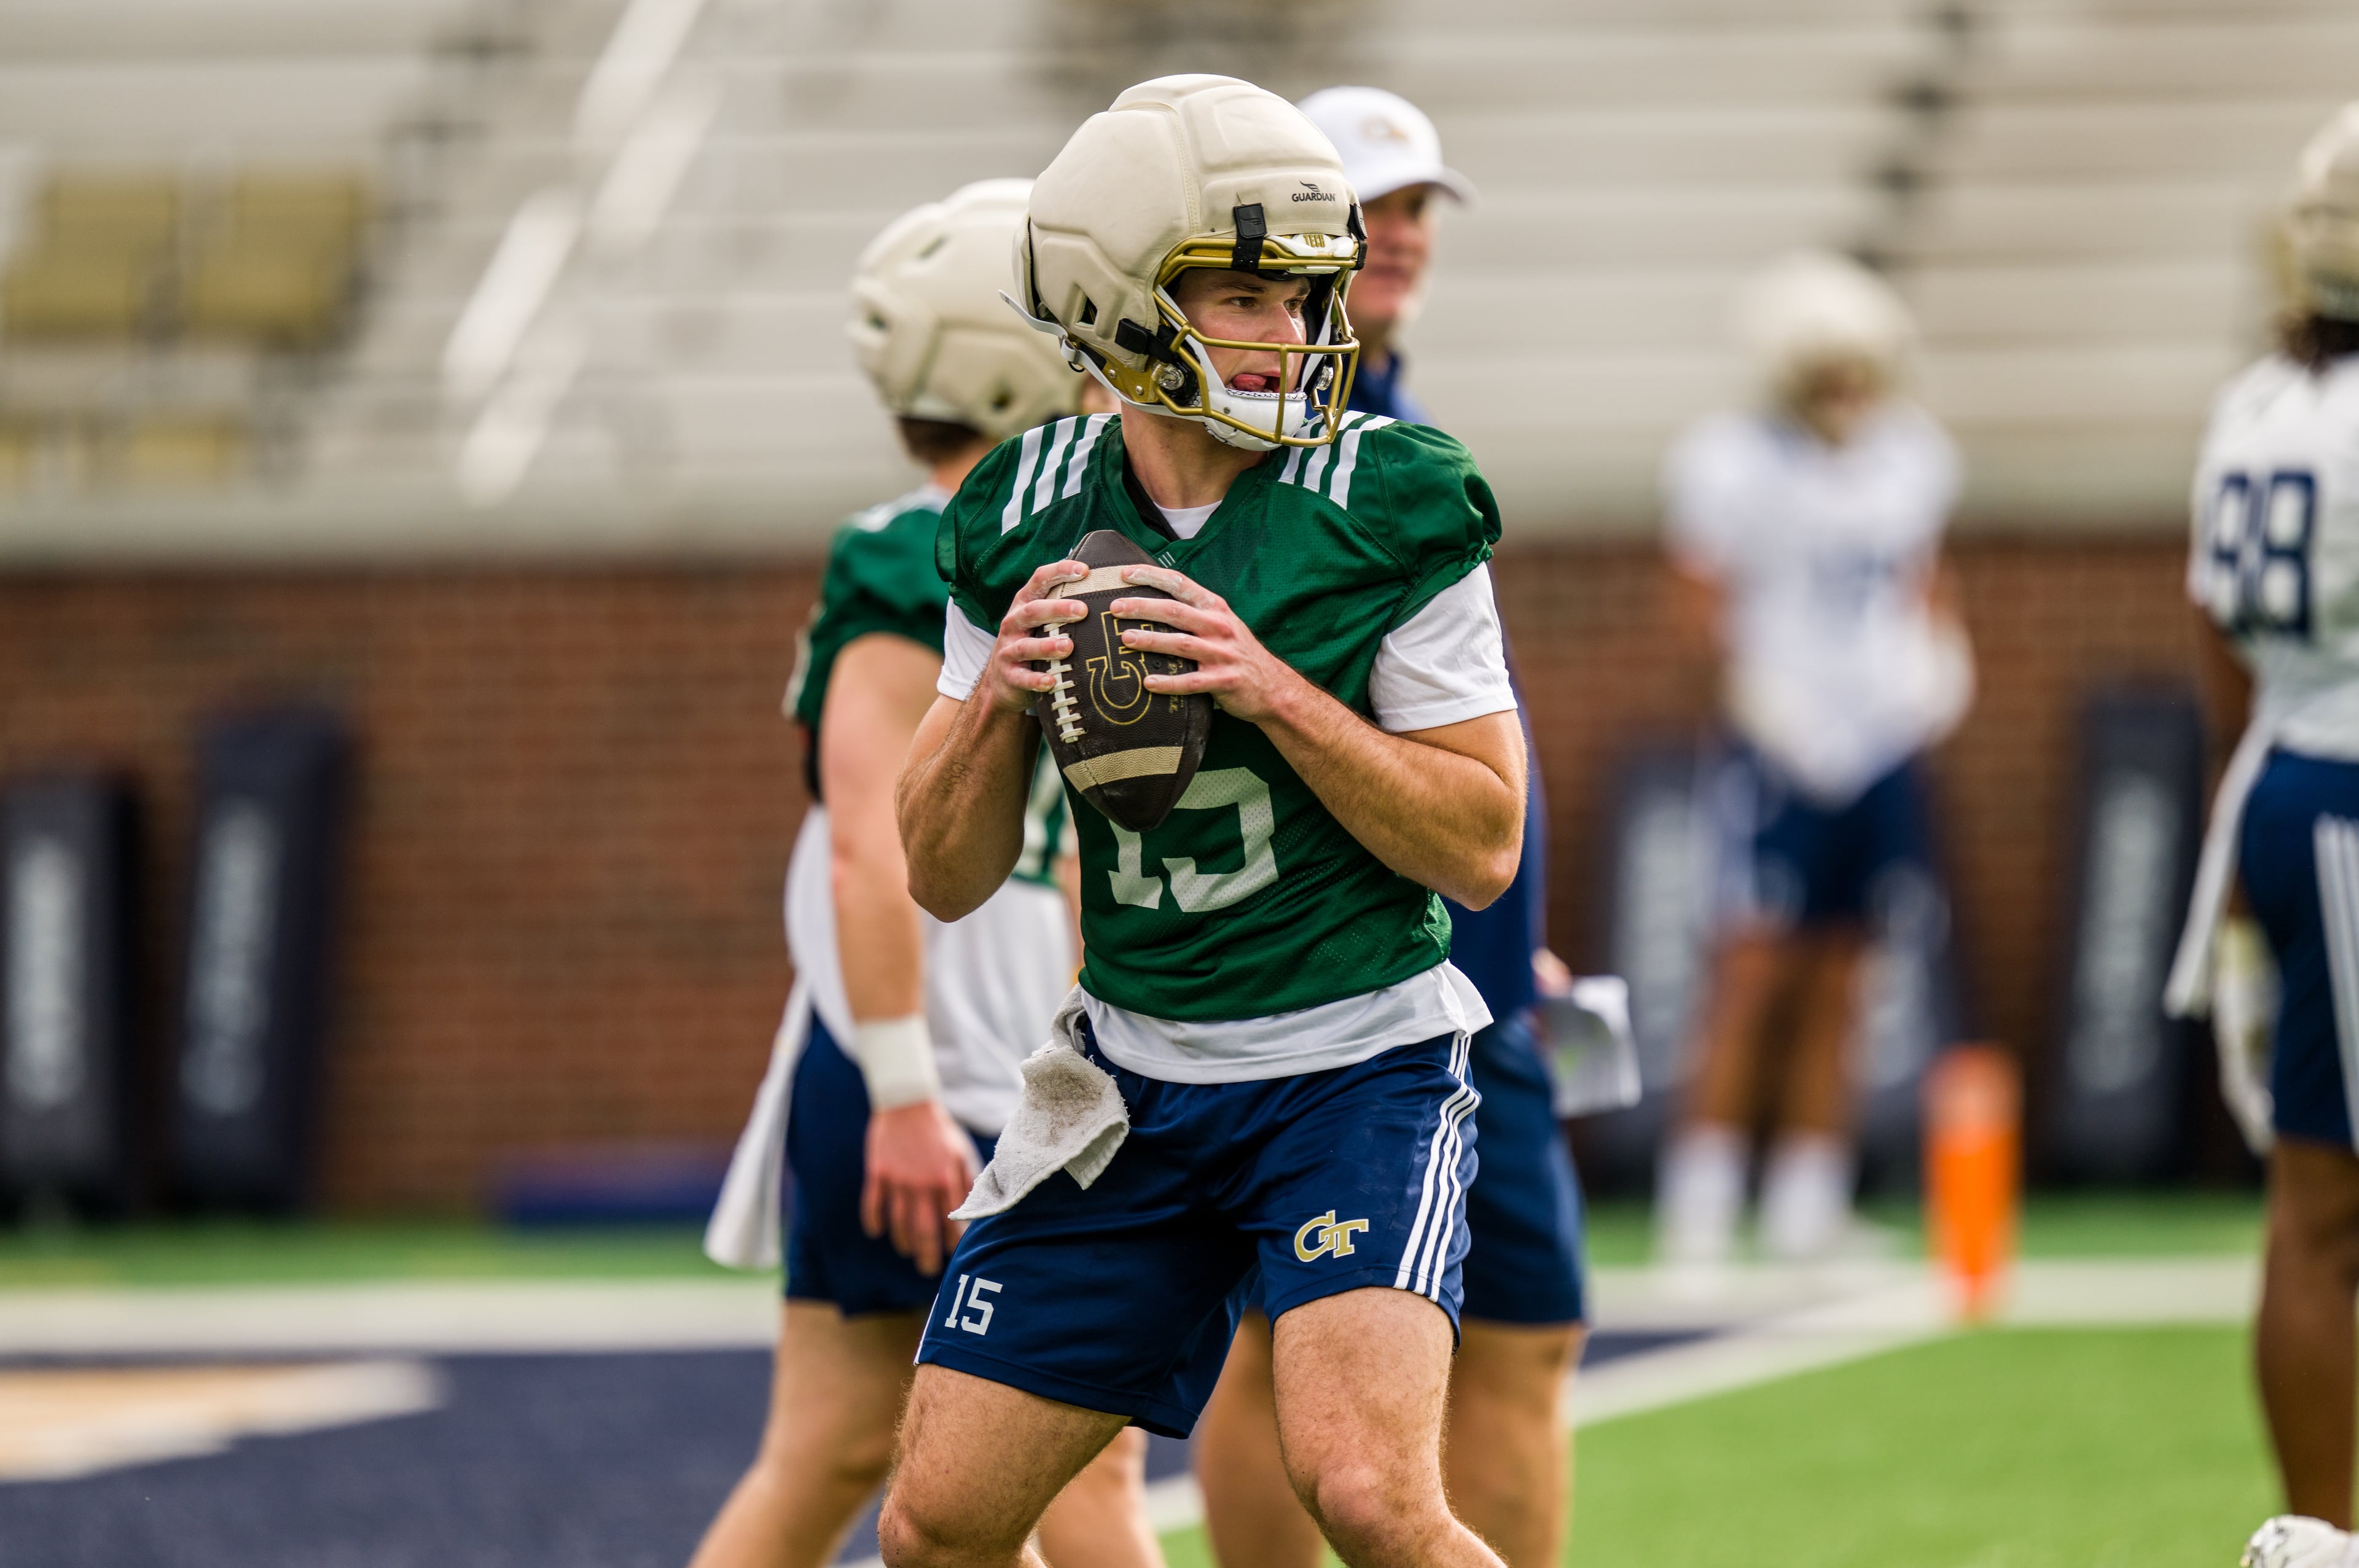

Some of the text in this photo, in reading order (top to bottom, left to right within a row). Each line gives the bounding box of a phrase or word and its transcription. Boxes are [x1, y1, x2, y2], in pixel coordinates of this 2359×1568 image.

[1292, 192, 1336, 202] GUARDIAN
[1303, 235, 1325, 248] TECH
[1294, 1210, 1369, 1263] GT
[944, 1274, 1003, 1336] 15
